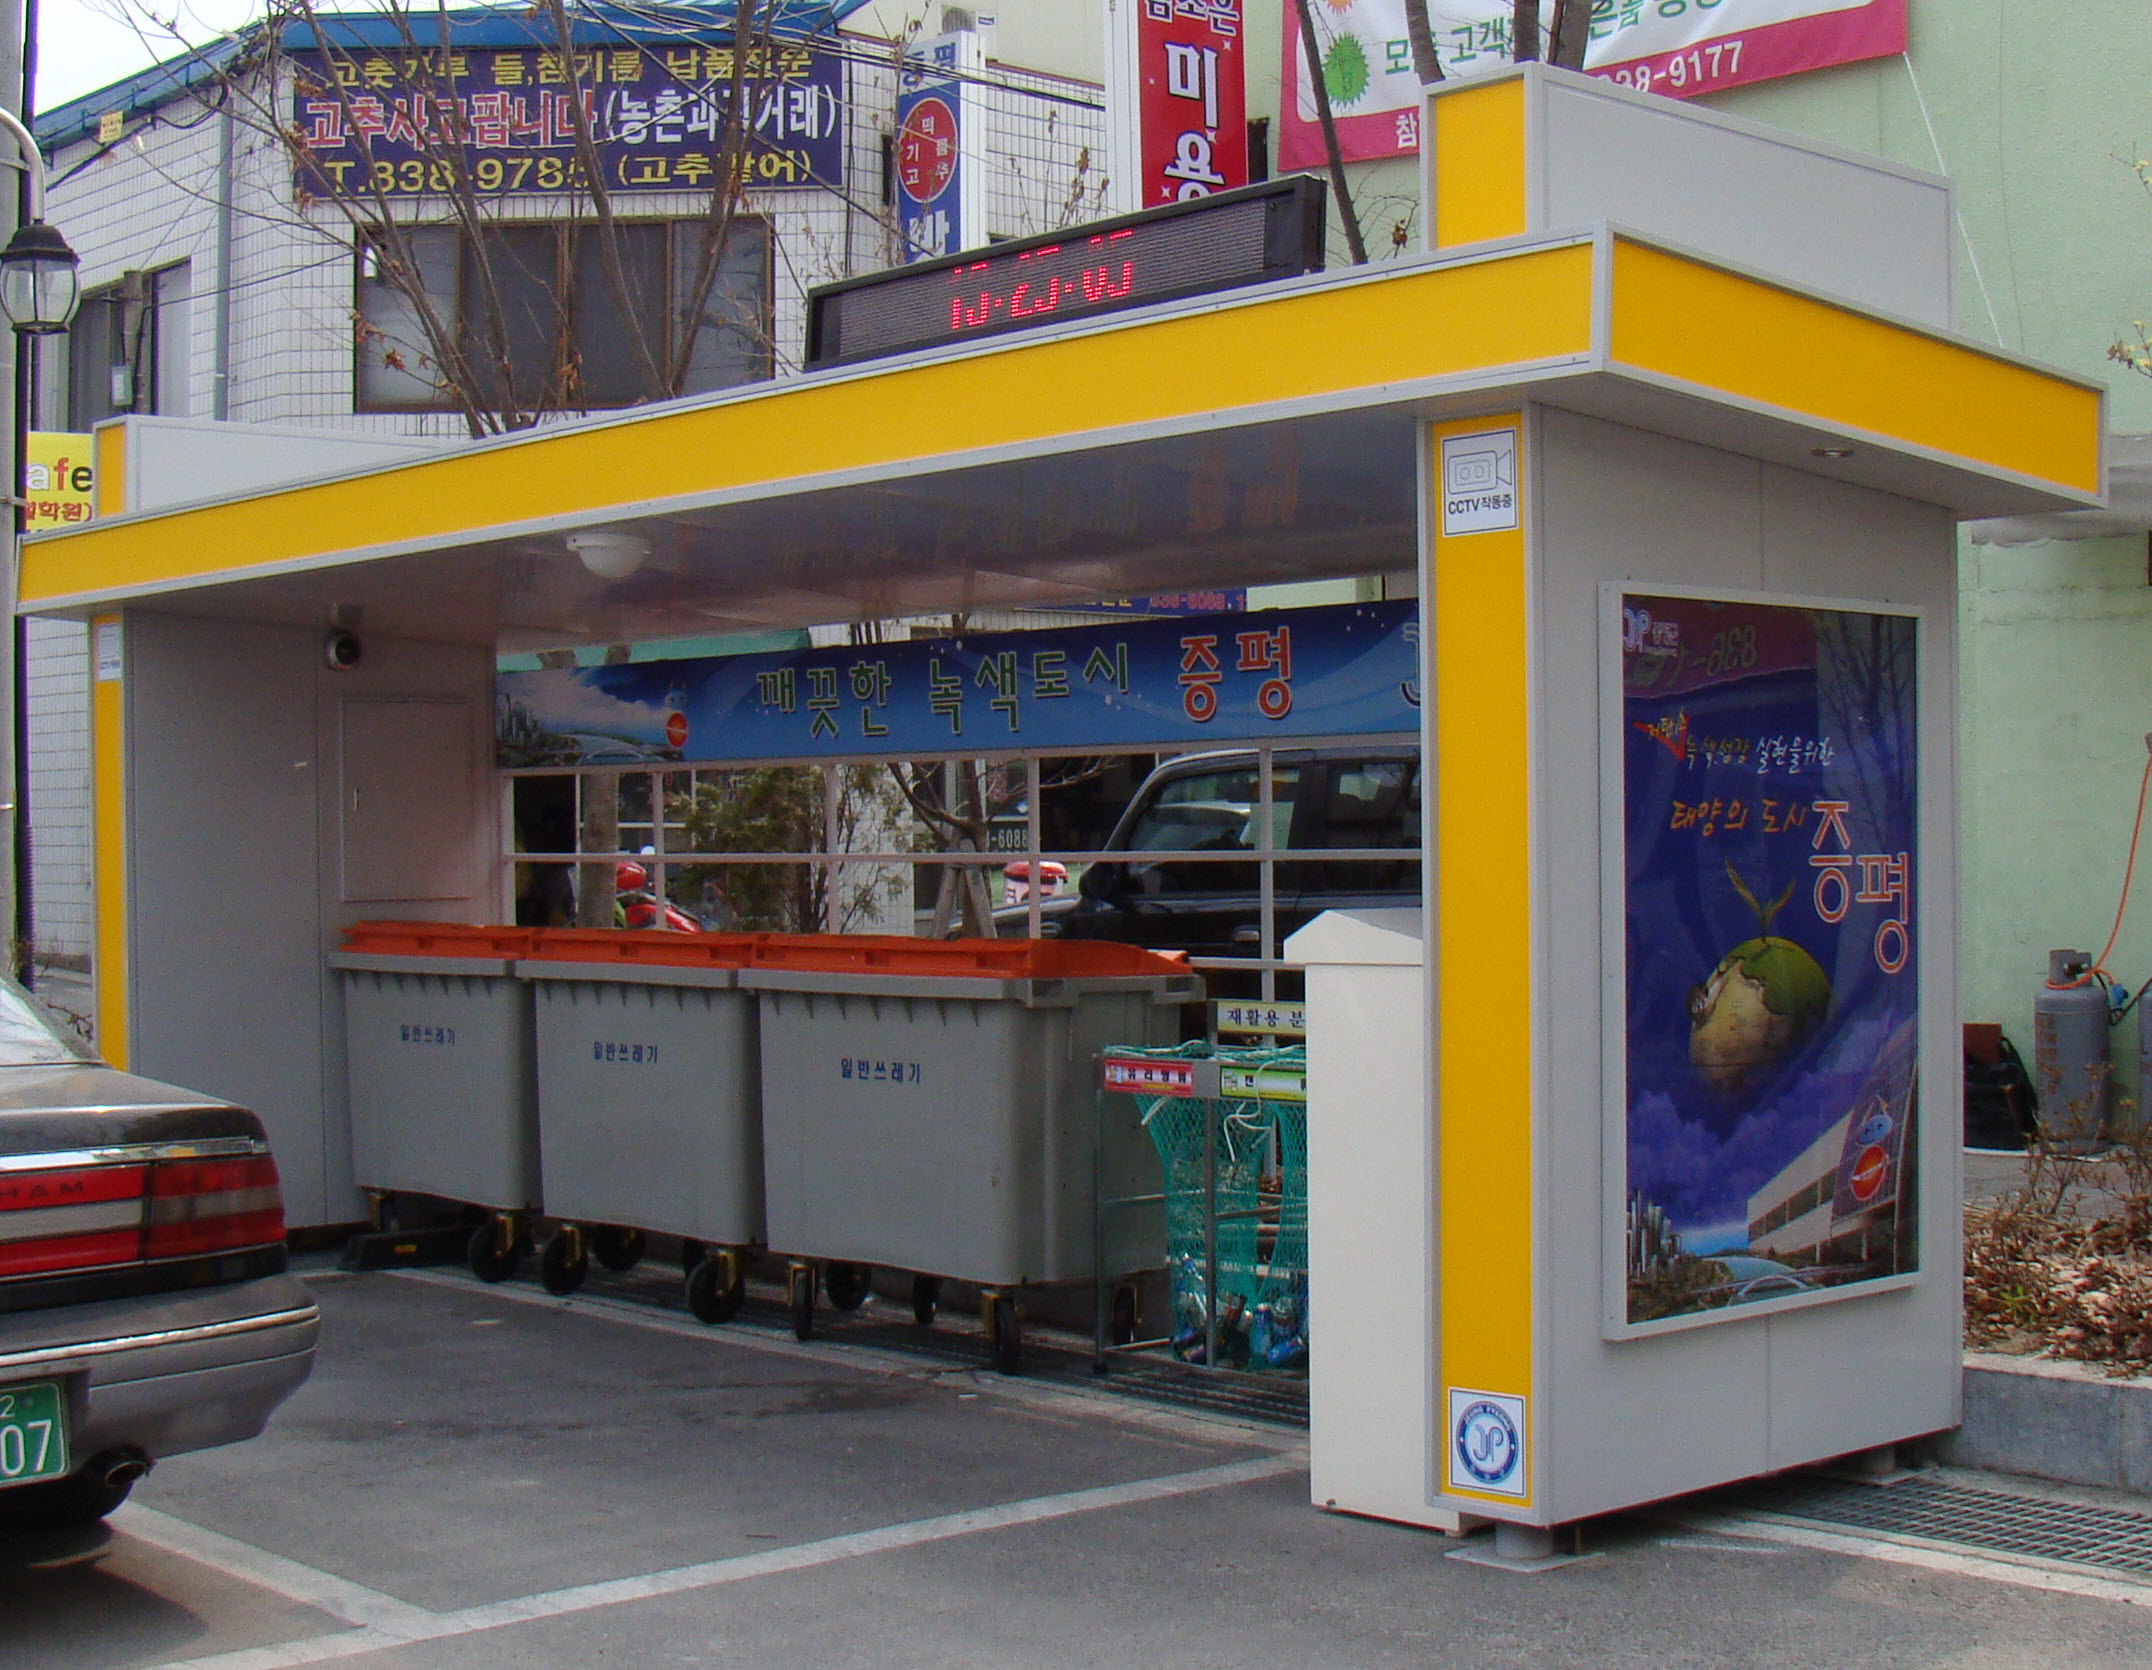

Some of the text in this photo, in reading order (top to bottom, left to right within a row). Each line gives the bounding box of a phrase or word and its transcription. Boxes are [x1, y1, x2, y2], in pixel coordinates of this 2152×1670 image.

[1384, 31, 1439, 76] 모
[1449, 16, 1515, 64] 고객
[757, 659, 893, 738] 깨끗한
[929, 640, 1129, 735] 녹색도시
[1177, 625, 1292, 723] 증평
[1670, 798, 1809, 837] 태양의 도시
[1808, 800, 1909, 976] 증평
[841, 1057, 921, 1084] 일반쓰레기
